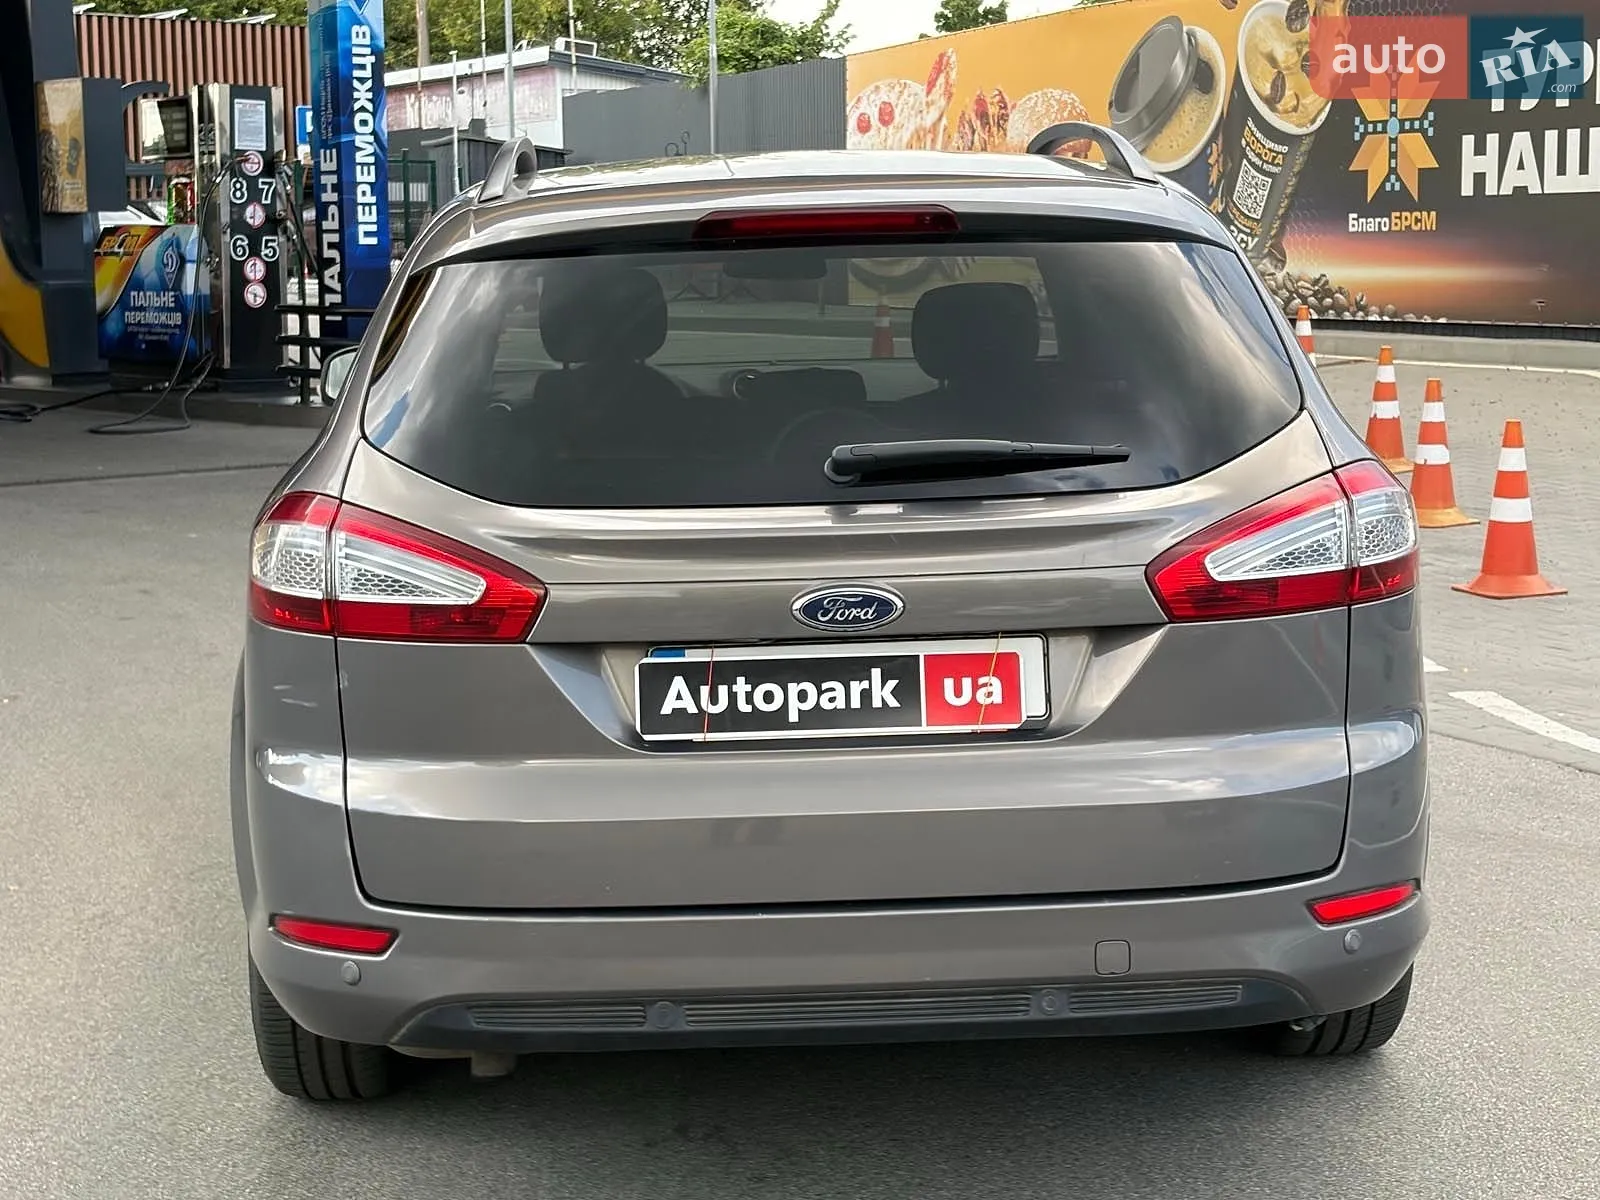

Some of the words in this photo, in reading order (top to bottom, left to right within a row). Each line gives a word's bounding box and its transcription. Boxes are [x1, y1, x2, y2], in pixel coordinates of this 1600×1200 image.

[351, 25, 378, 245] ПЕРЕМОЖЦІВ
[230, 177, 248, 204] 8
[258, 178, 276, 204] 7
[230, 234, 249, 261] 6
[260, 235, 280, 262] 5
[130, 291, 175, 308] ПАЛЬНЕ
[817, 596, 877, 622] Ford
[660, 667, 901, 723] Autopark
[943, 674, 1003, 707] ua
